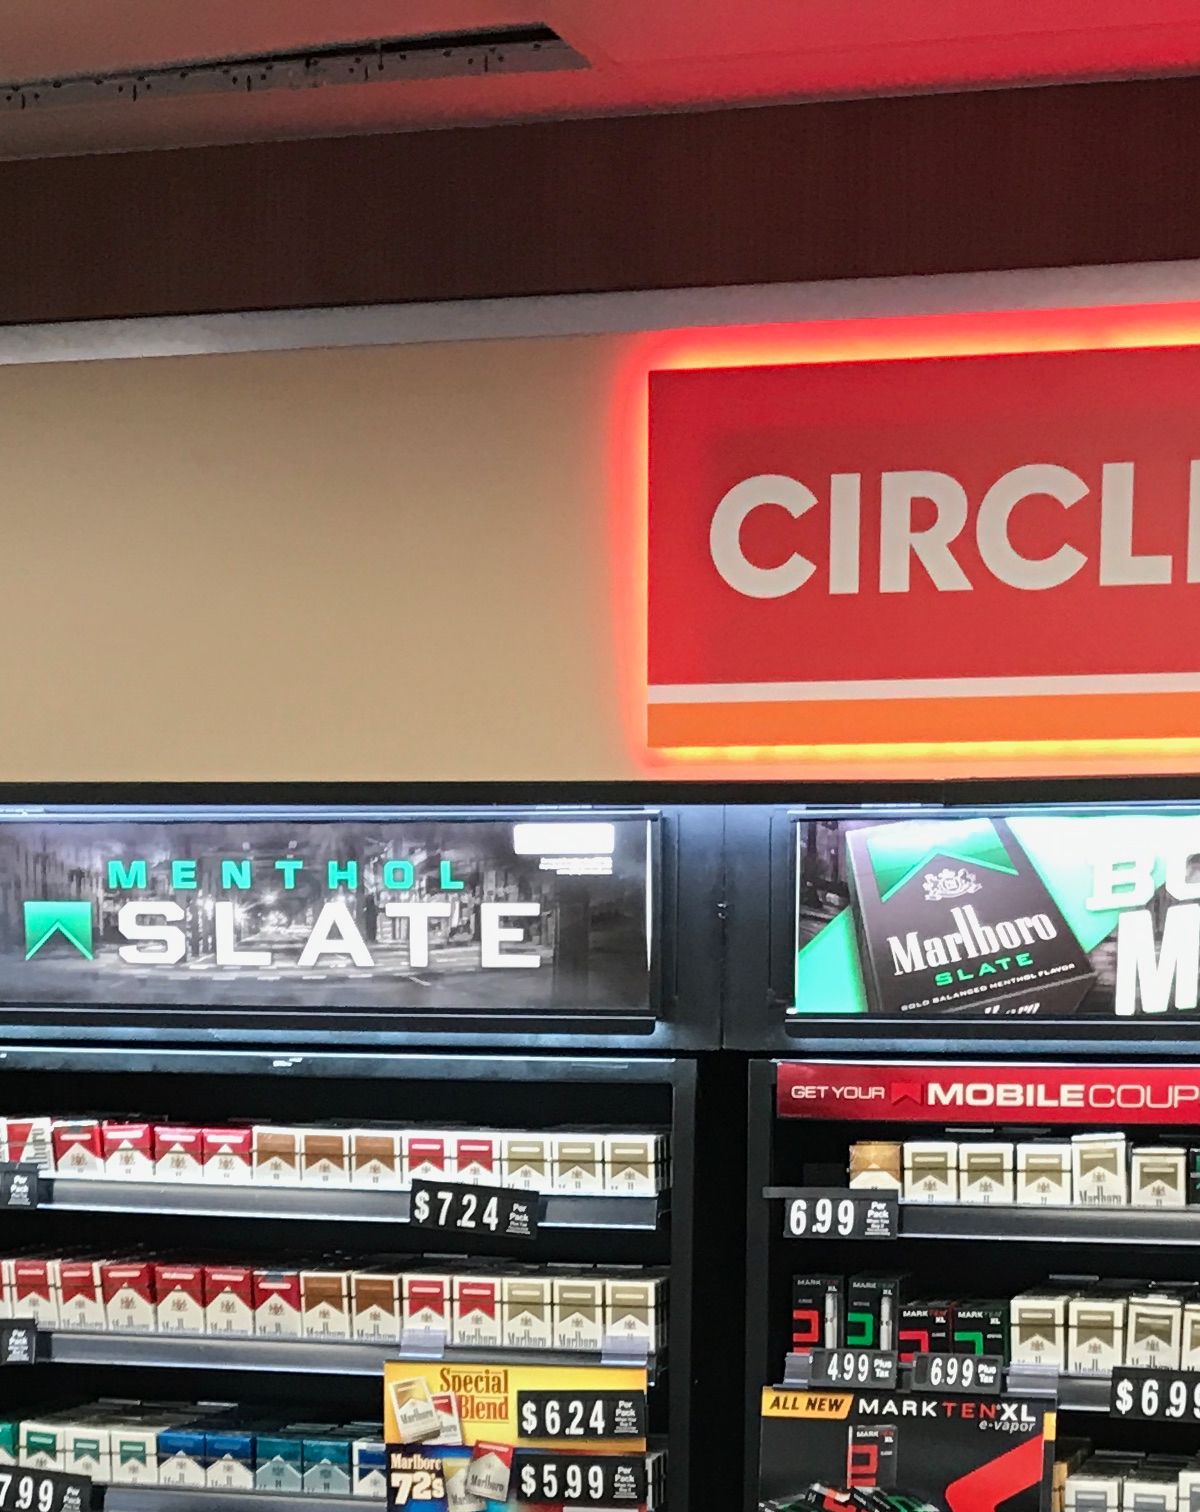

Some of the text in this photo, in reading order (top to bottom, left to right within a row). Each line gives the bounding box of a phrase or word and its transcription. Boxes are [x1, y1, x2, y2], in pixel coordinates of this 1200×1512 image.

[709, 459, 1200, 599] CIRCL
[108, 860, 464, 889] MENTHOL
[118, 901, 541, 968] SLATE
[887, 903, 1057, 976] Marlboro
[933, 985, 987, 1004] BALANCED
[989, 973, 1037, 990] MENTHOL
[1038, 963, 1075, 977] FLAVOR
[935, 952, 1033, 986] SLATE
[791, 1086, 829, 1100] GET
[832, 1086, 885, 1099] YOUR
[414, 1189, 498, 1231] $7.24
[790, 1198, 854, 1236] 6.99
[871, 1201, 886, 1210] Per
[867, 1209, 889, 1218] Pack
[440, 1367, 509, 1394] Special
[827, 1353, 892, 1382] 4.99 Plus
[875, 1368, 890, 1378] Tax
[930, 1357, 997, 1387] 6.99 Plus
[980, 1373, 994, 1384] Tax
[458, 1395, 509, 1420] Blend
[522, 1400, 605, 1435] $6.24
[619, 1401, 632, 1409] Per
[770, 1396, 844, 1412] ALL NEW
[390, 1453, 442, 1470] Marlboro
[391, 1471, 445, 1505] 72's
[471, 1474, 504, 1492] Marlboro
[521, 1464, 603, 1499] $5.99
[617, 1467, 632, 1475] Per
